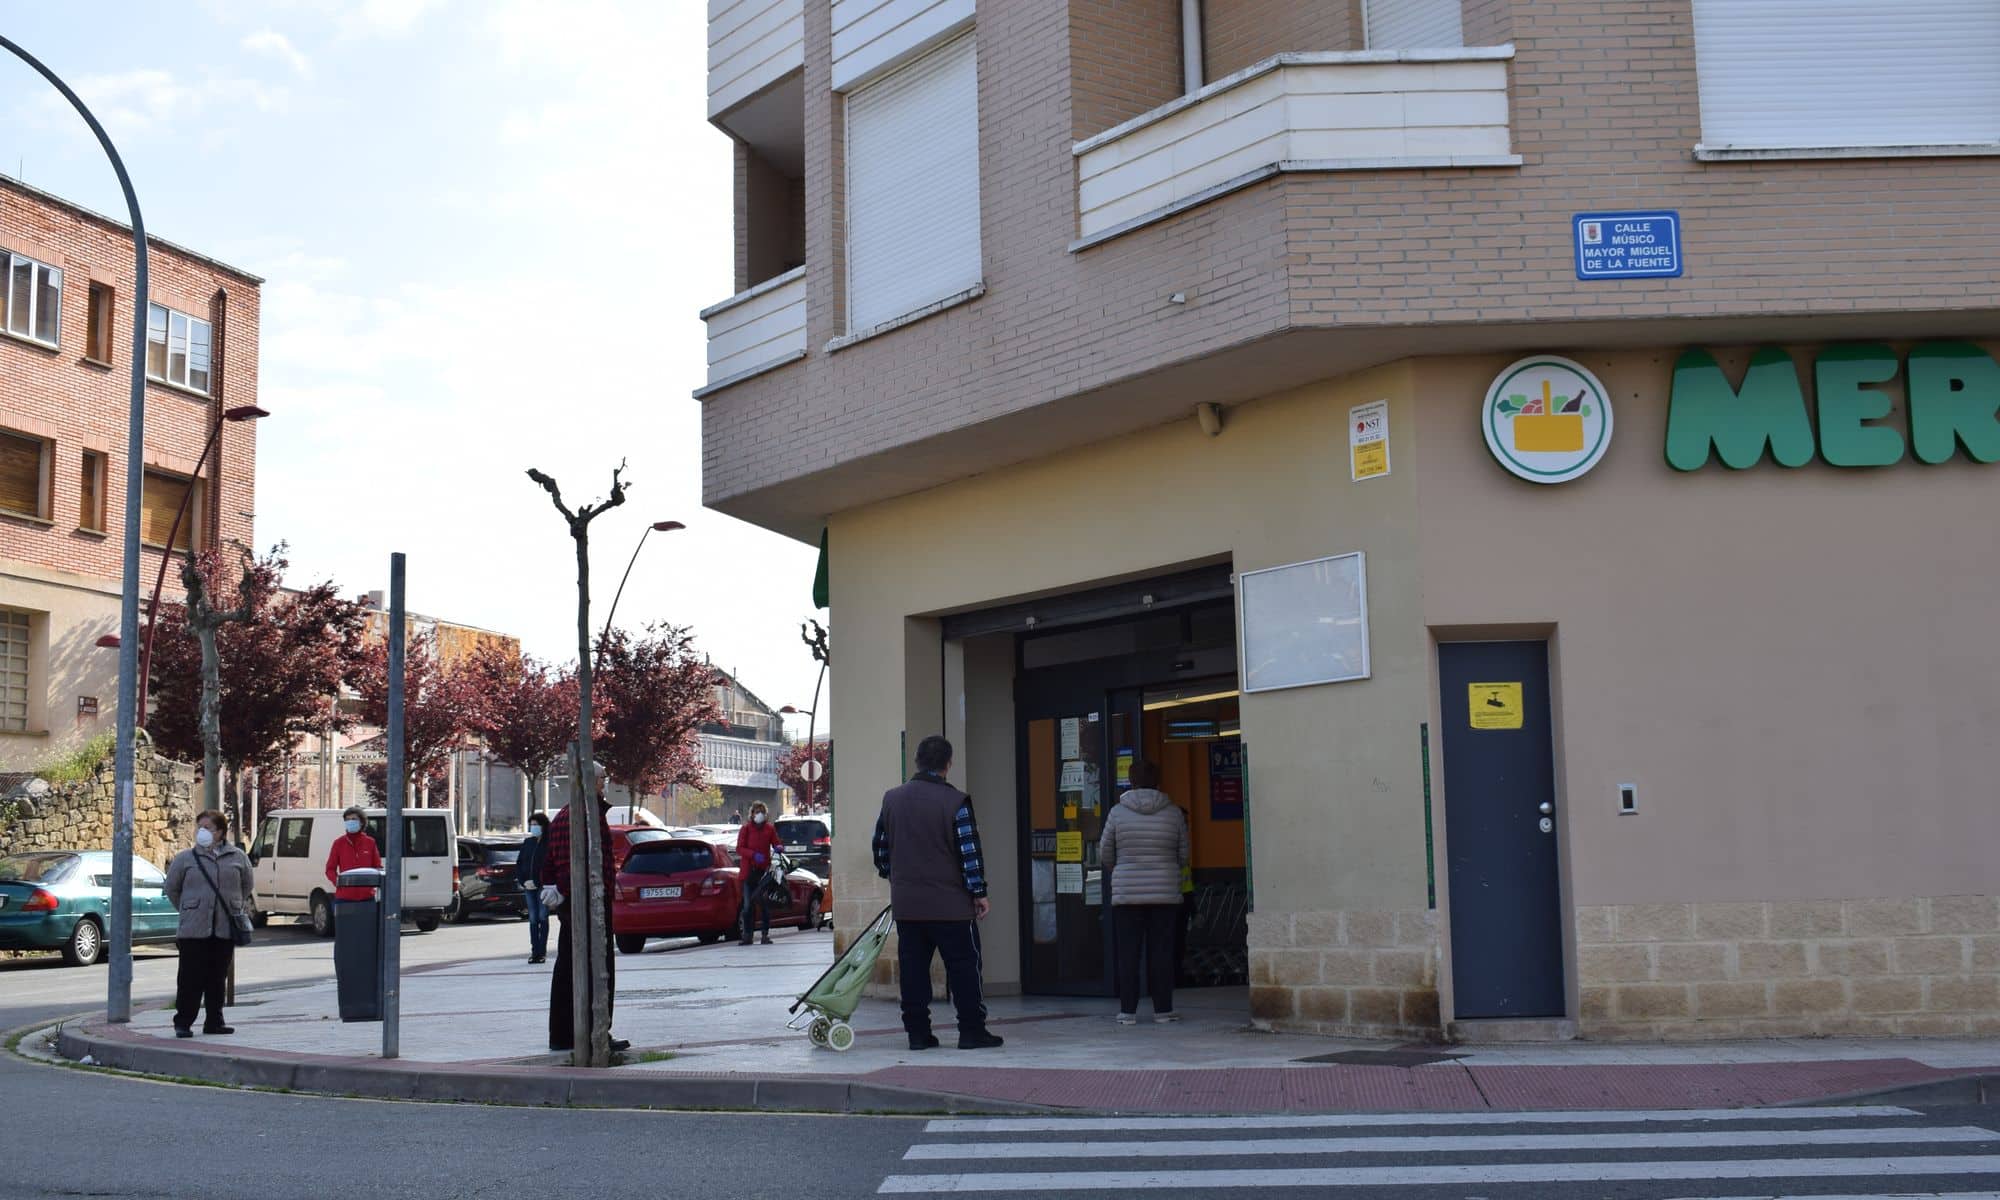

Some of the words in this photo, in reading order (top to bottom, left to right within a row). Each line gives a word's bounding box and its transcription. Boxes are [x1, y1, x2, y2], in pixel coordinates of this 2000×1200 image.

[1615, 223, 1650, 233] CALLE
[1612, 234, 1655, 245] MÚSICO
[1585, 248, 1625, 257] MAYOR
[1630, 246, 1672, 256] MIGUEL
[1587, 260, 1602, 269] DE
[1608, 259, 1623, 268] LA
[1628, 257, 1671, 268] FUENTE
[1664, 341, 2000, 471] MER
[1365, 418, 1380, 429] NST
